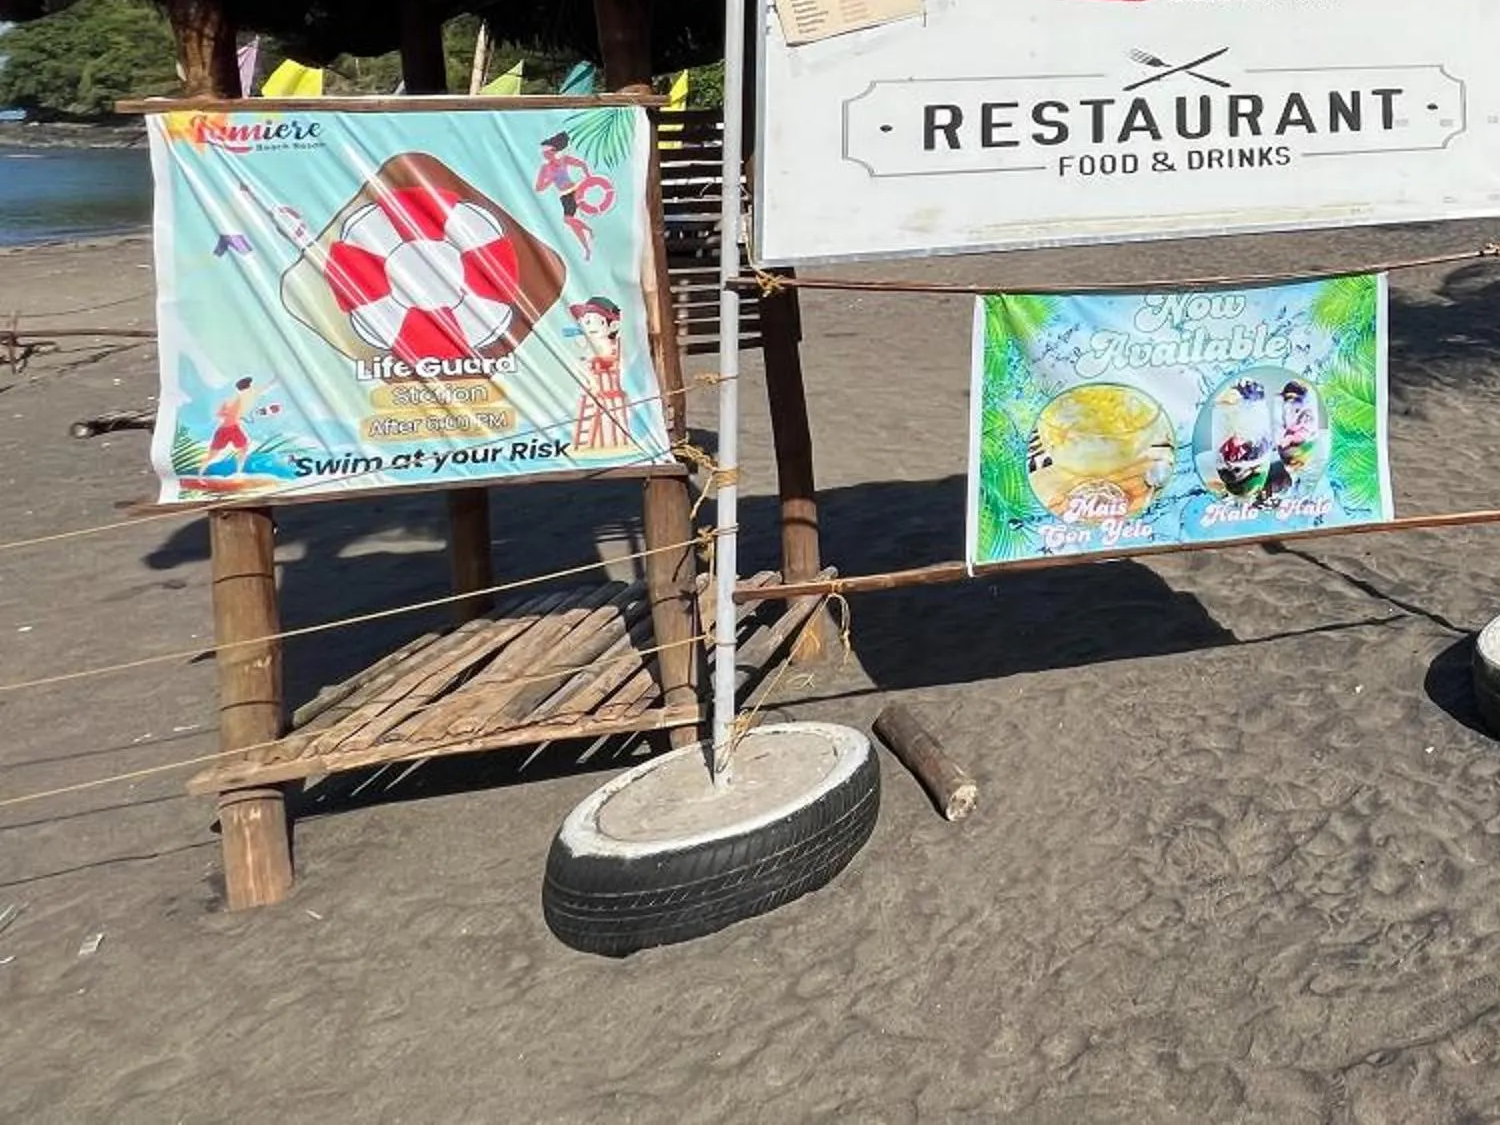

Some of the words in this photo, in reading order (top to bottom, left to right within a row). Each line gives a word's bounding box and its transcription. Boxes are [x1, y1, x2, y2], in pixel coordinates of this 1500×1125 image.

[922, 87, 1404, 152] RESTAURANT
[1058, 153, 1140, 177] FOOD
[1151, 151, 1177, 173] &
[1187, 145, 1292, 172] DRINKS
[1134, 291, 1248, 333] Now
[356, 356, 412, 380] Life
[415, 352, 517, 378] Guard
[1076, 321, 1294, 379] Available
[392, 384, 488, 406] Station
[370, 417, 422, 437] After
[295, 453, 384, 477] Swim
[391, 448, 424, 470] at
[433, 446, 503, 474] your
[509, 437, 572, 463] Risk
[1063, 497, 1129, 524] Mais
